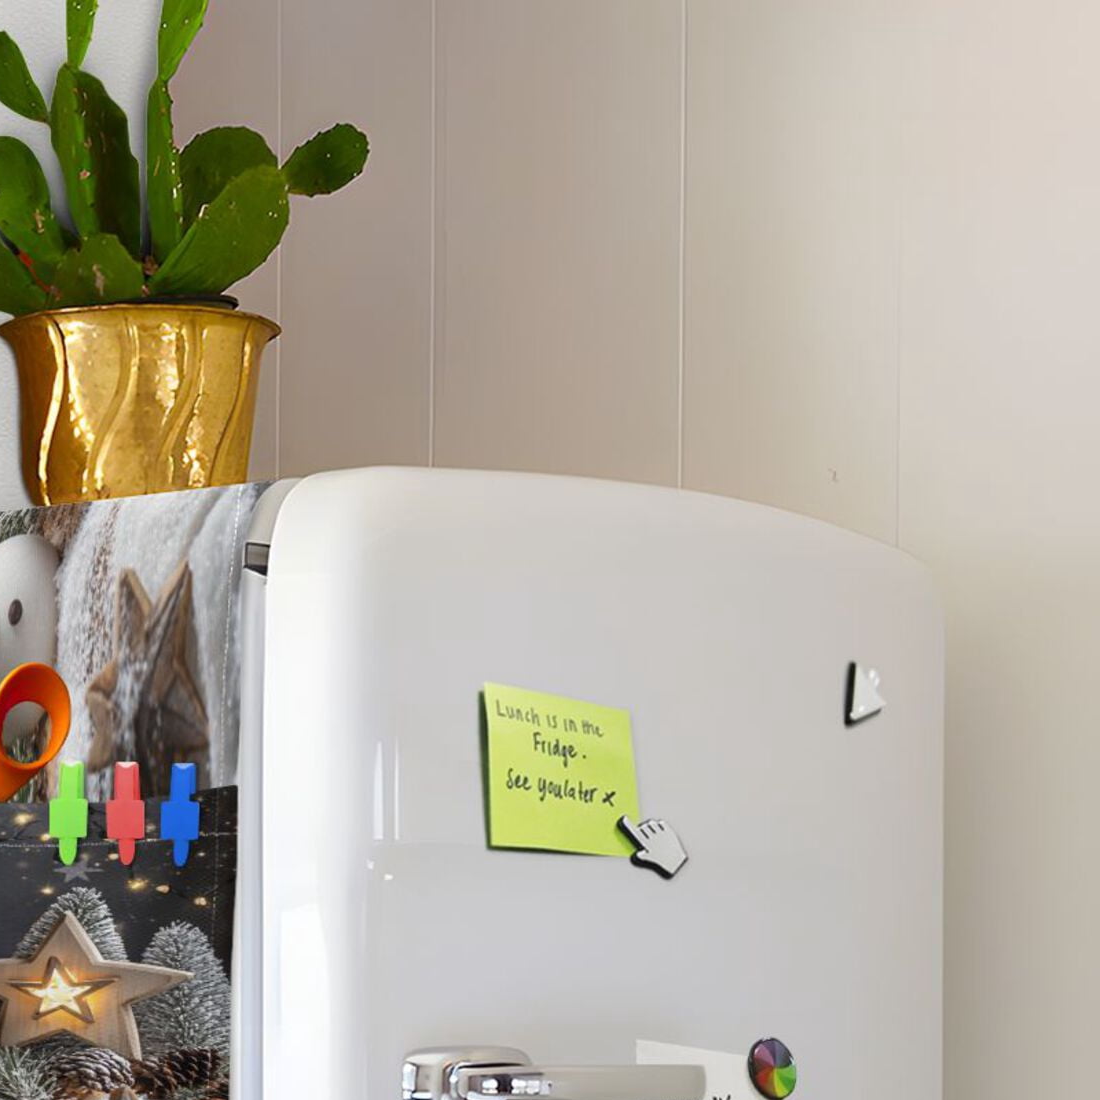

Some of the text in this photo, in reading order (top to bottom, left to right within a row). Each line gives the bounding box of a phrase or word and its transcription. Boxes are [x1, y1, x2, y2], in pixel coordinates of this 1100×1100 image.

[496, 699, 604, 738] Lunch is in the
[506, 767, 532, 792] See
